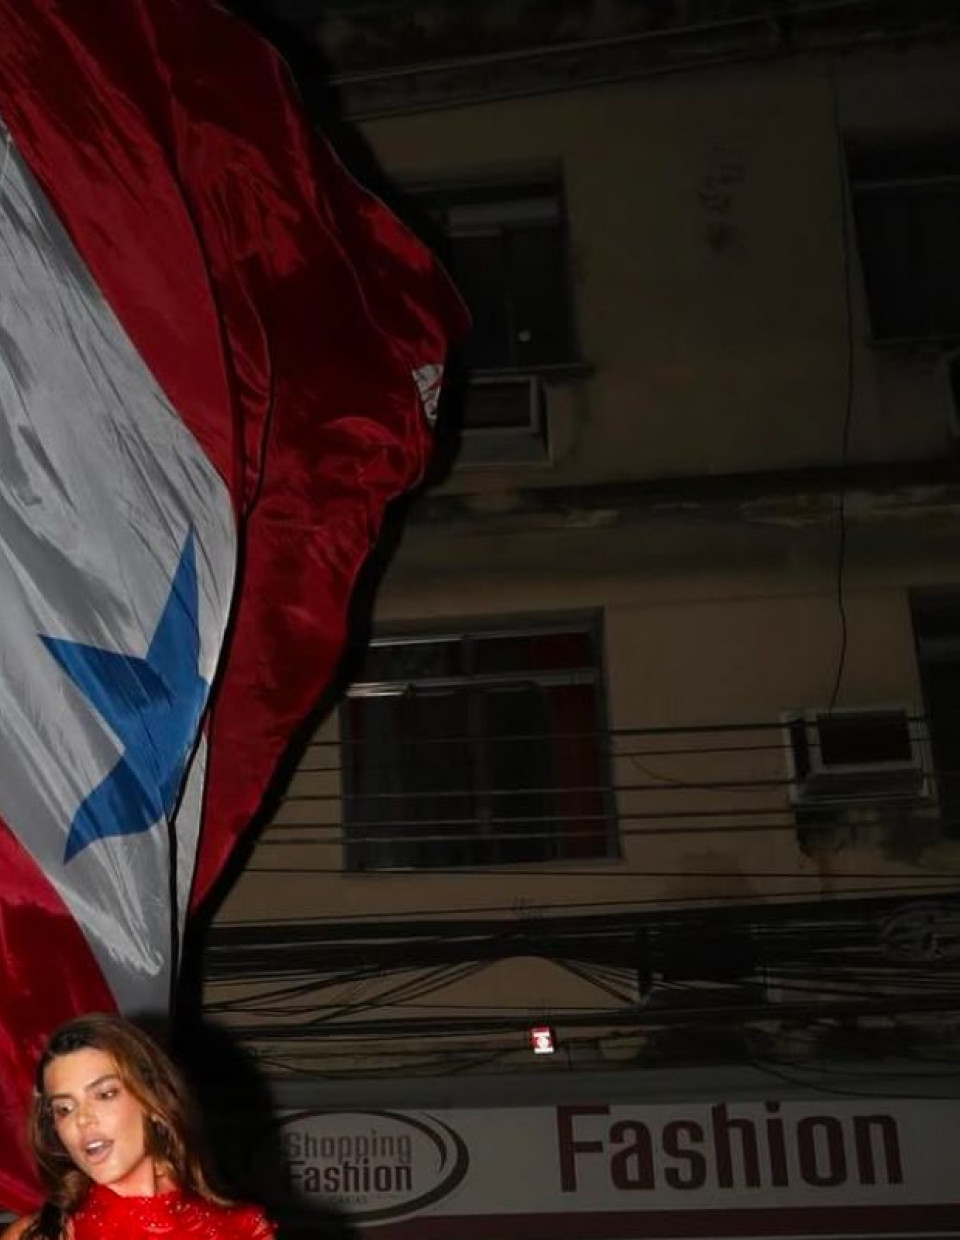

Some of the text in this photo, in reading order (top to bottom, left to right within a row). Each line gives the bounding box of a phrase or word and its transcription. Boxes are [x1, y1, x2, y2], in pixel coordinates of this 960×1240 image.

[283, 1129, 411, 1164] Shopping
[556, 1100, 904, 1192] Fashion
[285, 1158, 412, 1192] Fashion
